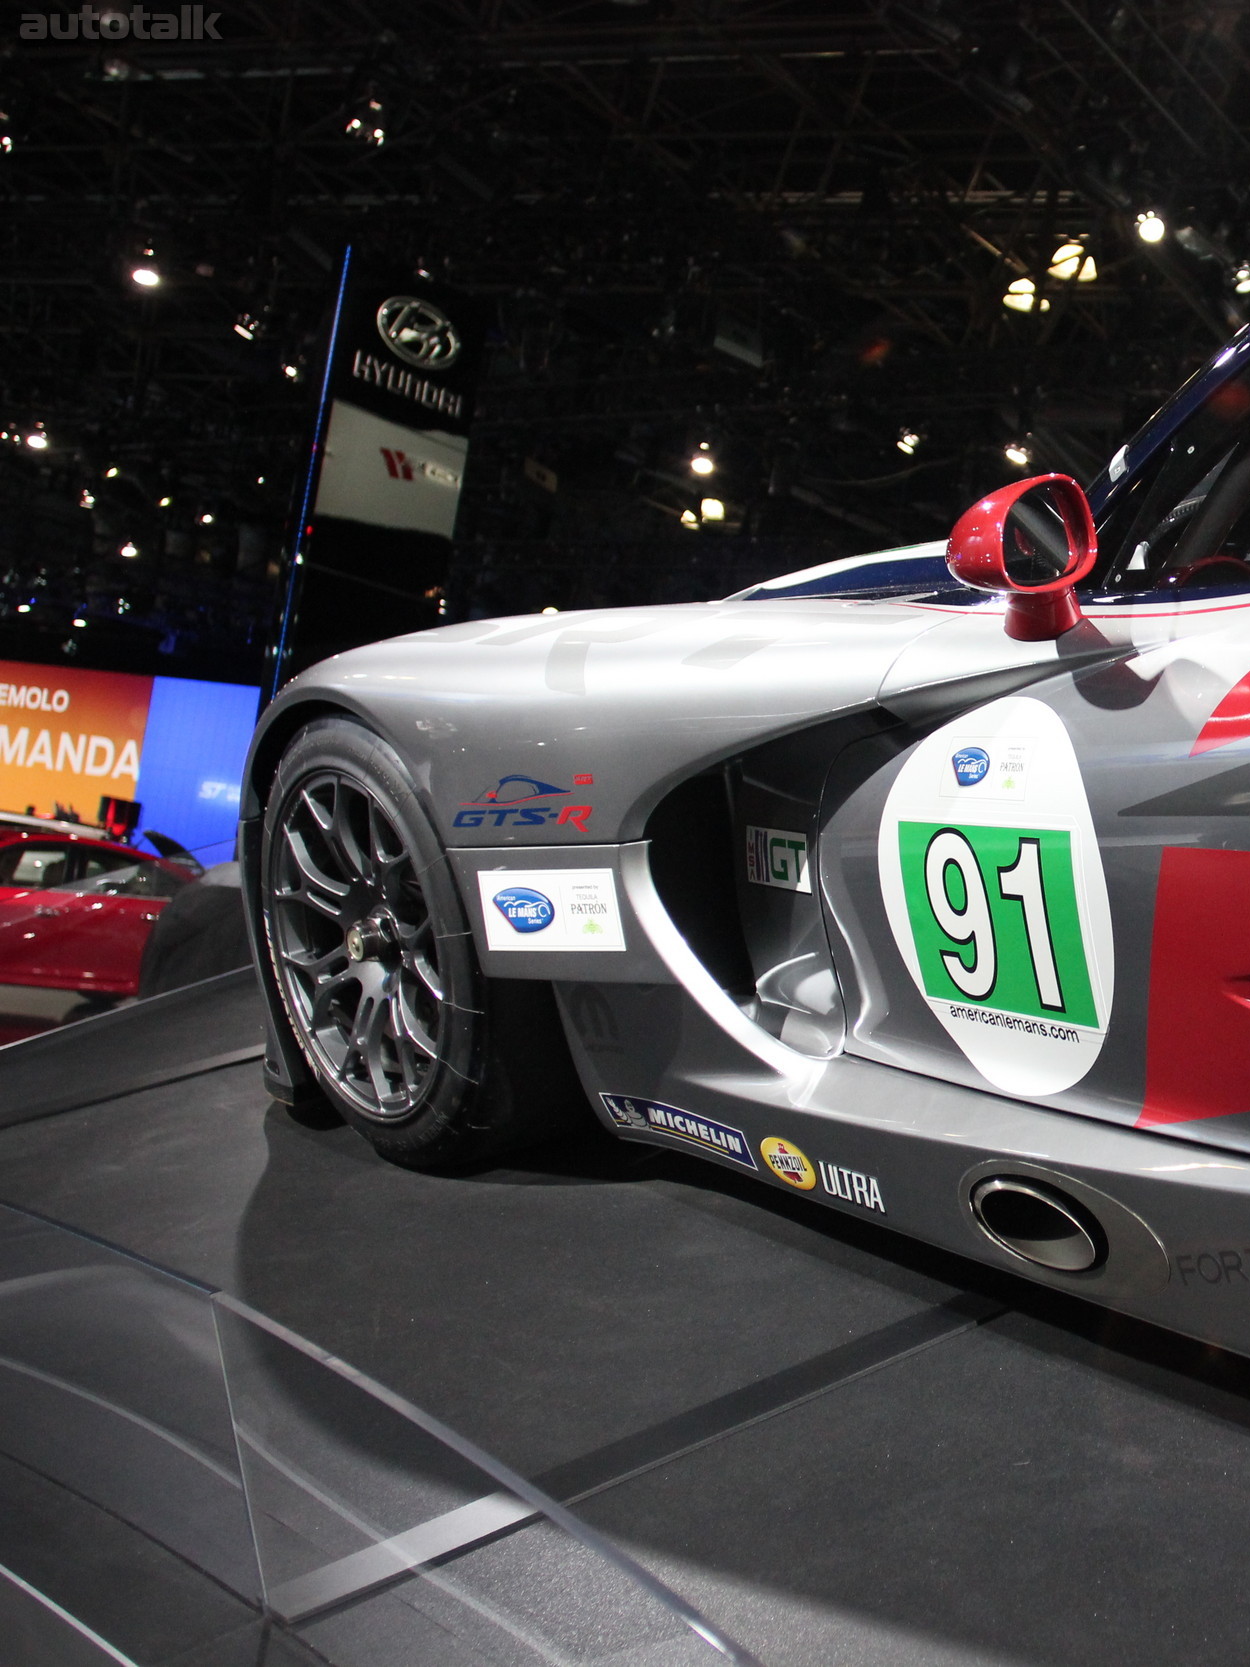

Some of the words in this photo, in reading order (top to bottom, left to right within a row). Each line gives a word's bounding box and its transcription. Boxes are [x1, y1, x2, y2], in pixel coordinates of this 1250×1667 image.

[352, 348, 463, 419] HYUNDAI
[0, 724, 139, 782] MANDA
[452, 805, 593, 833] GTS-R
[770, 837, 806, 883] GT
[508, 907, 517, 918] LE
[517, 907, 538, 918] MANS
[923, 827, 1067, 1014] 91
[949, 1004, 1081, 1043] americanlemans.com
[648, 1107, 743, 1155] MICHELIN
[768, 1153, 808, 1172] PENNZOIL
[818, 1160, 887, 1213] ULTRA
